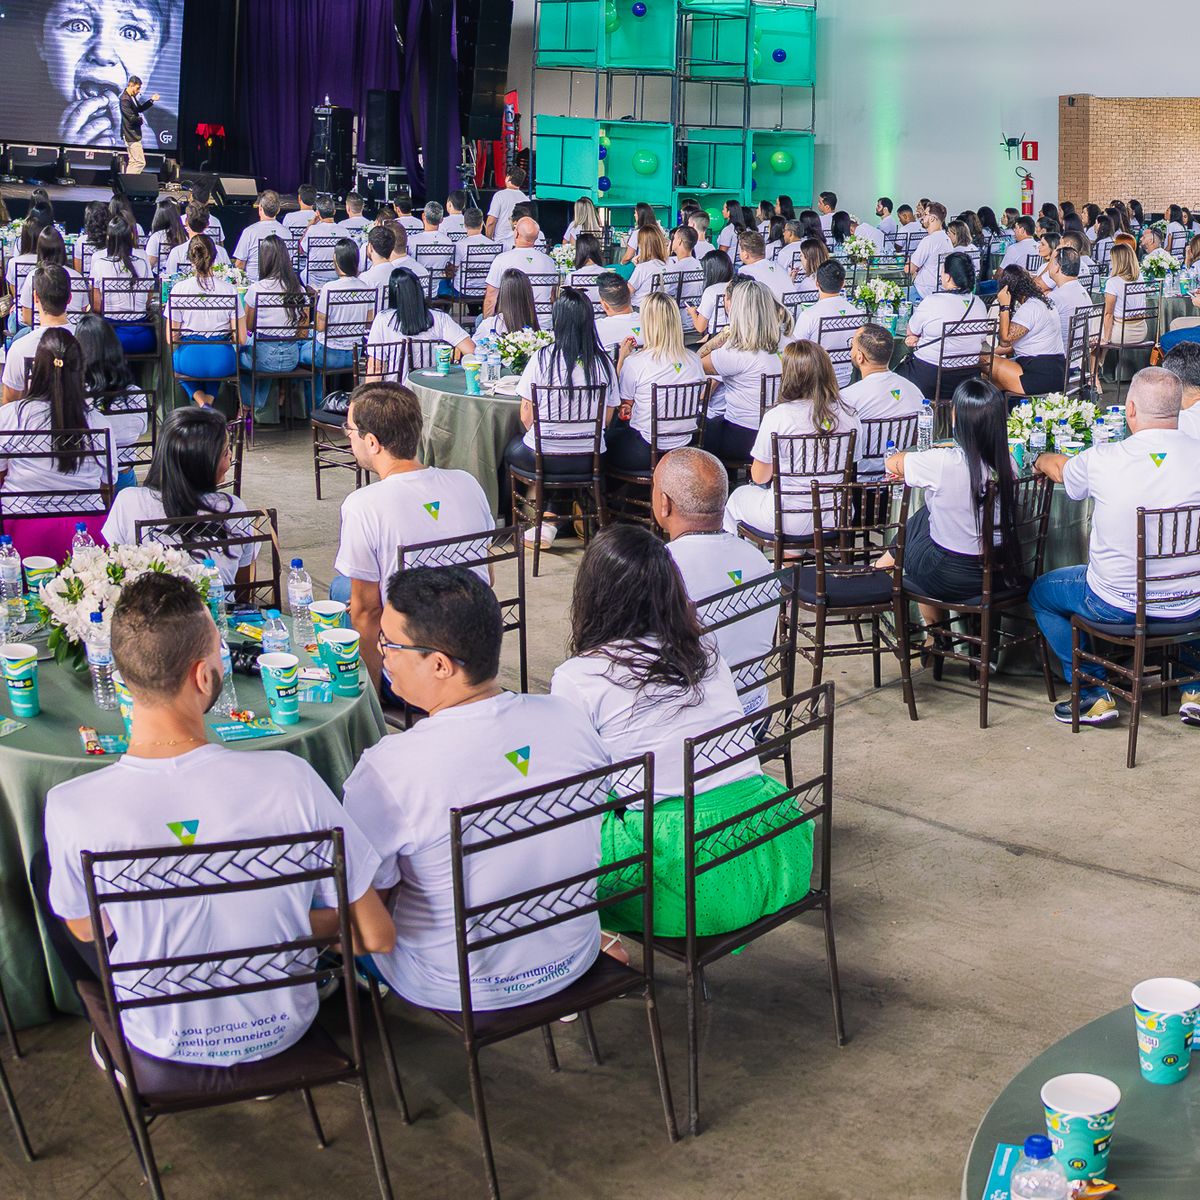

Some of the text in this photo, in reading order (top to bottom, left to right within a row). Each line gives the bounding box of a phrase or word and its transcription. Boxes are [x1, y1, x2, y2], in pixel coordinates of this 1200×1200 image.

[177, 1036, 220, 1047] melhor
[223, 1030, 271, 1044] maneira
[273, 1025, 286, 1035] de
[181, 1029, 203, 1037] sou
[205, 1020, 248, 1036] porque
[251, 1014, 277, 1027] você
[207, 1048, 241, 1058] quem
